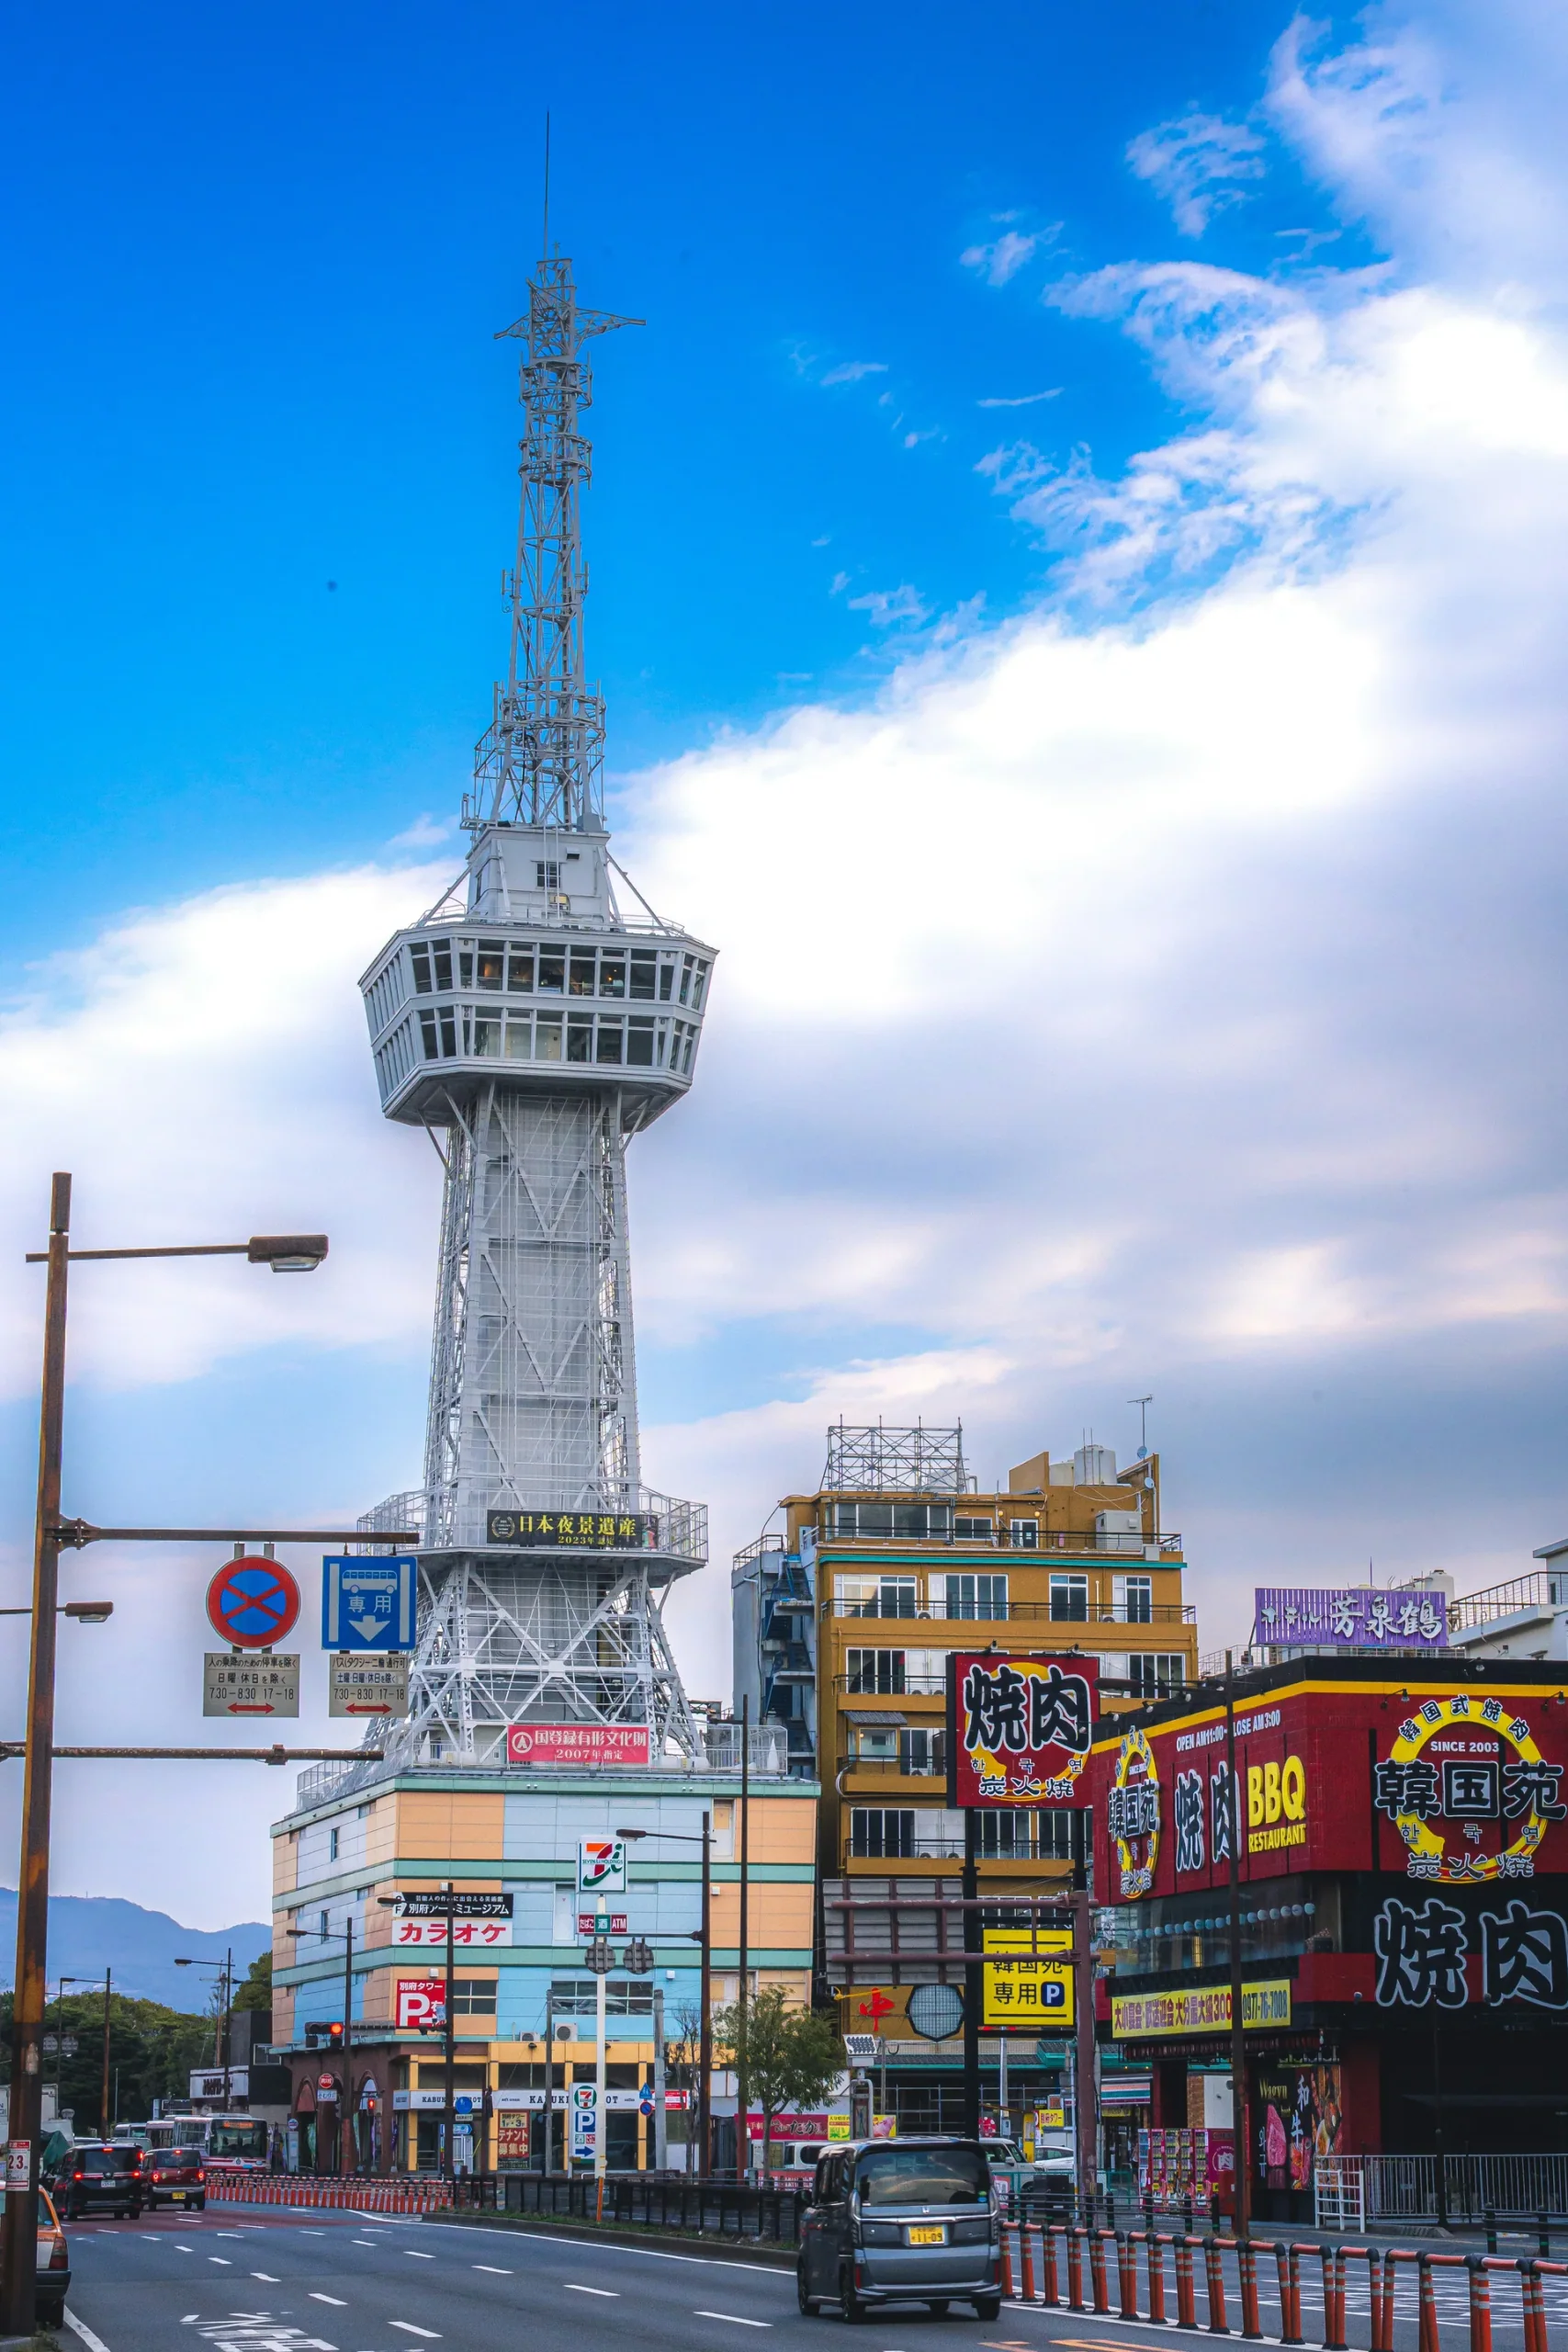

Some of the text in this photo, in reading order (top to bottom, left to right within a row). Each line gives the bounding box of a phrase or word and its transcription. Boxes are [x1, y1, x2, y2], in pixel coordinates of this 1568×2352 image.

[520, 1514, 637, 1536] 日本夜景遺産
[348, 1596, 391, 1614] 専用
[209, 1656, 296, 1668] 人の乗降のための停車を除く
[964, 1664, 1092, 1754] 焼肉
[535, 1730, 647, 1747] 国登録有形文化財
[1176, 1733, 1194, 1752] OPEN
[1233, 1717, 1252, 1737] LOSE
[1430, 1740, 1500, 1753] SINCE 2003
[979, 1774, 1074, 1799] 炭火焼
[1247, 1755, 1307, 1828] BBQ
[1374, 1758, 1568, 1821] 韓国苑
[1108, 1780, 1160, 1841] 韓国苑
[1248, 1823, 1306, 1854] RESTAURANT
[1407, 1851, 1535, 1880] 炭火焼
[409, 1904, 509, 1915] 別府アーミュージアム
[415, 1894, 503, 1903] 芸能人の作に出会える美術館
[399, 1923, 506, 1943] カラオケ
[612, 1918, 626, 1929] ATM
[1374, 1897, 1568, 2010] 焼肉
[400, 1982, 443, 1991] 別府タワー
[993, 1982, 1037, 2005] 専用
[400, 1993, 431, 2027] P
[577, 2112, 594, 2132] P
[1291, 2074, 1310, 2149] 和牛
[499, 2129, 528, 2142] テナント
[499, 2143, 528, 2155] 募集中
